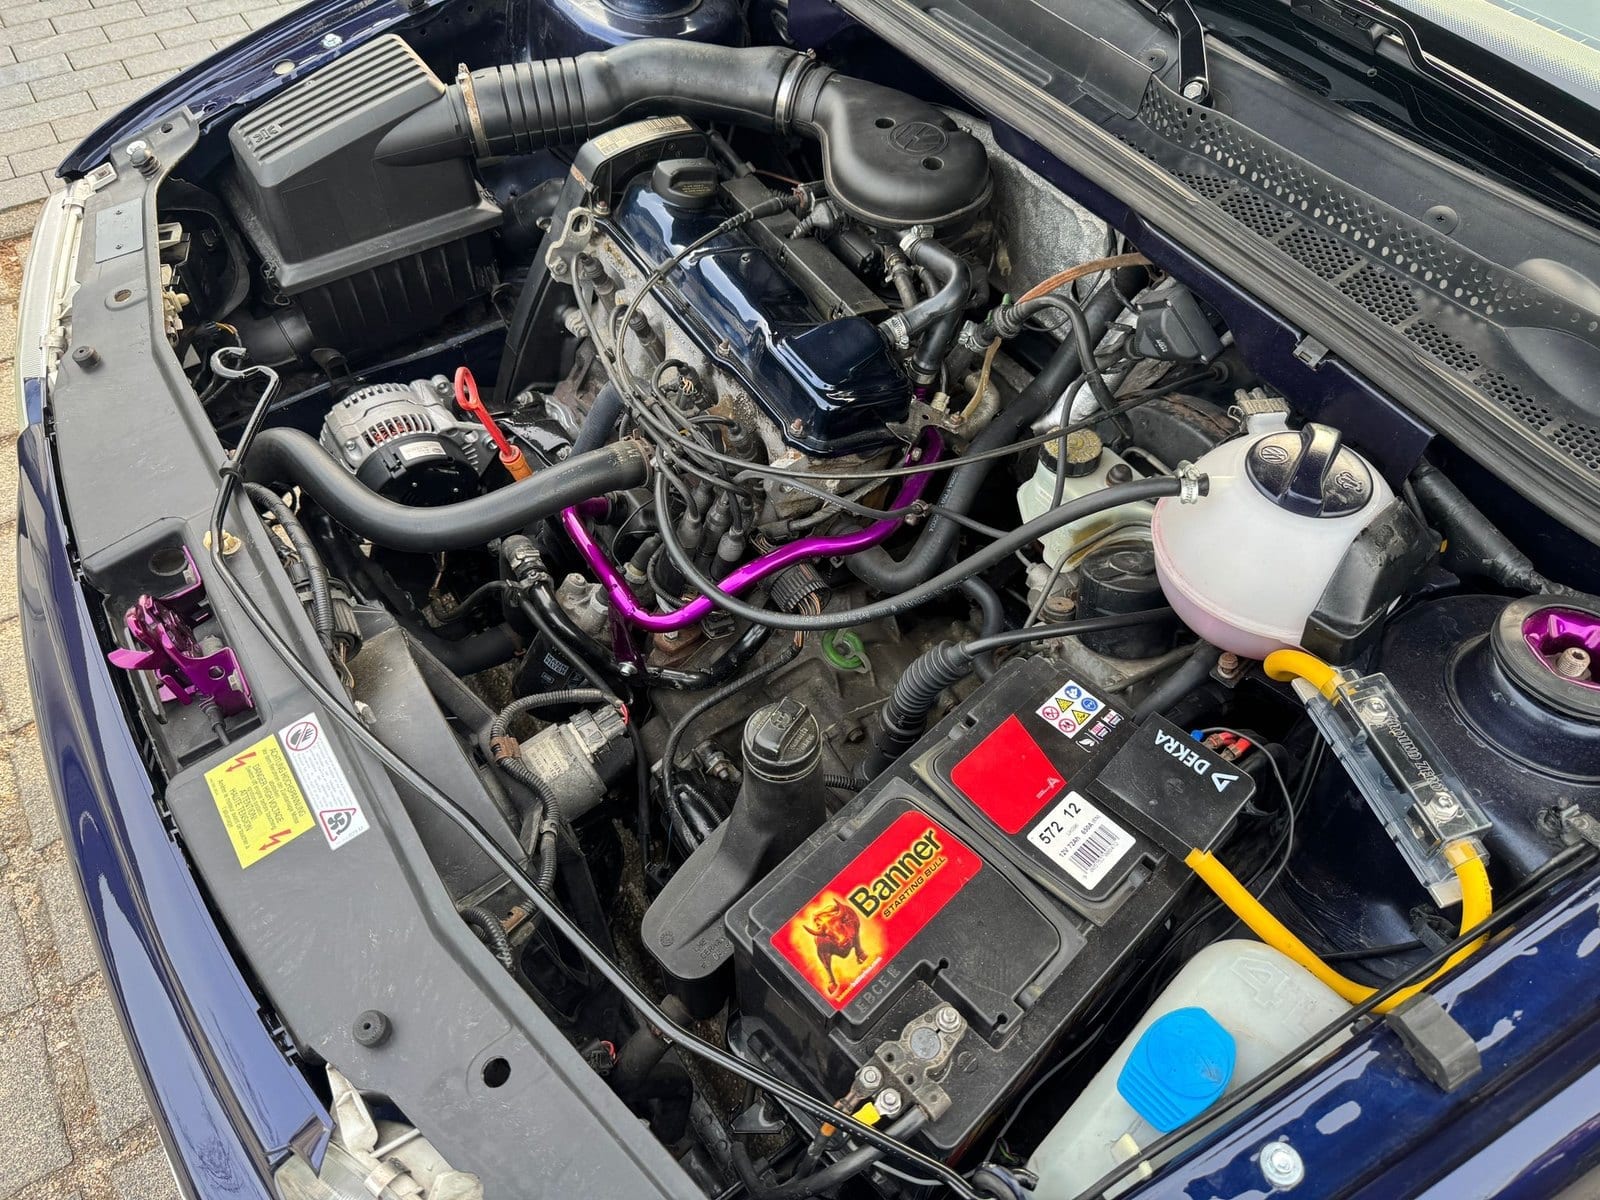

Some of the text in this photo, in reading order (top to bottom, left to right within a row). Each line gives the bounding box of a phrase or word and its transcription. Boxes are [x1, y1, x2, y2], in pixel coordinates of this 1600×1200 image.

[268, 747, 284, 773] ACHTUNG
[1154, 728, 1211, 775] DEKRA
[228, 787, 244, 808] HAUTE
[250, 763, 268, 787] DANGER
[266, 798, 285, 823] VOLTAGE
[1039, 821, 1064, 844] 572
[1064, 803, 1081, 818] 12
[1067, 836, 1081, 851] 72Ah
[845, 828, 943, 918] Banner
[882, 855, 946, 917] STARTING BULL
